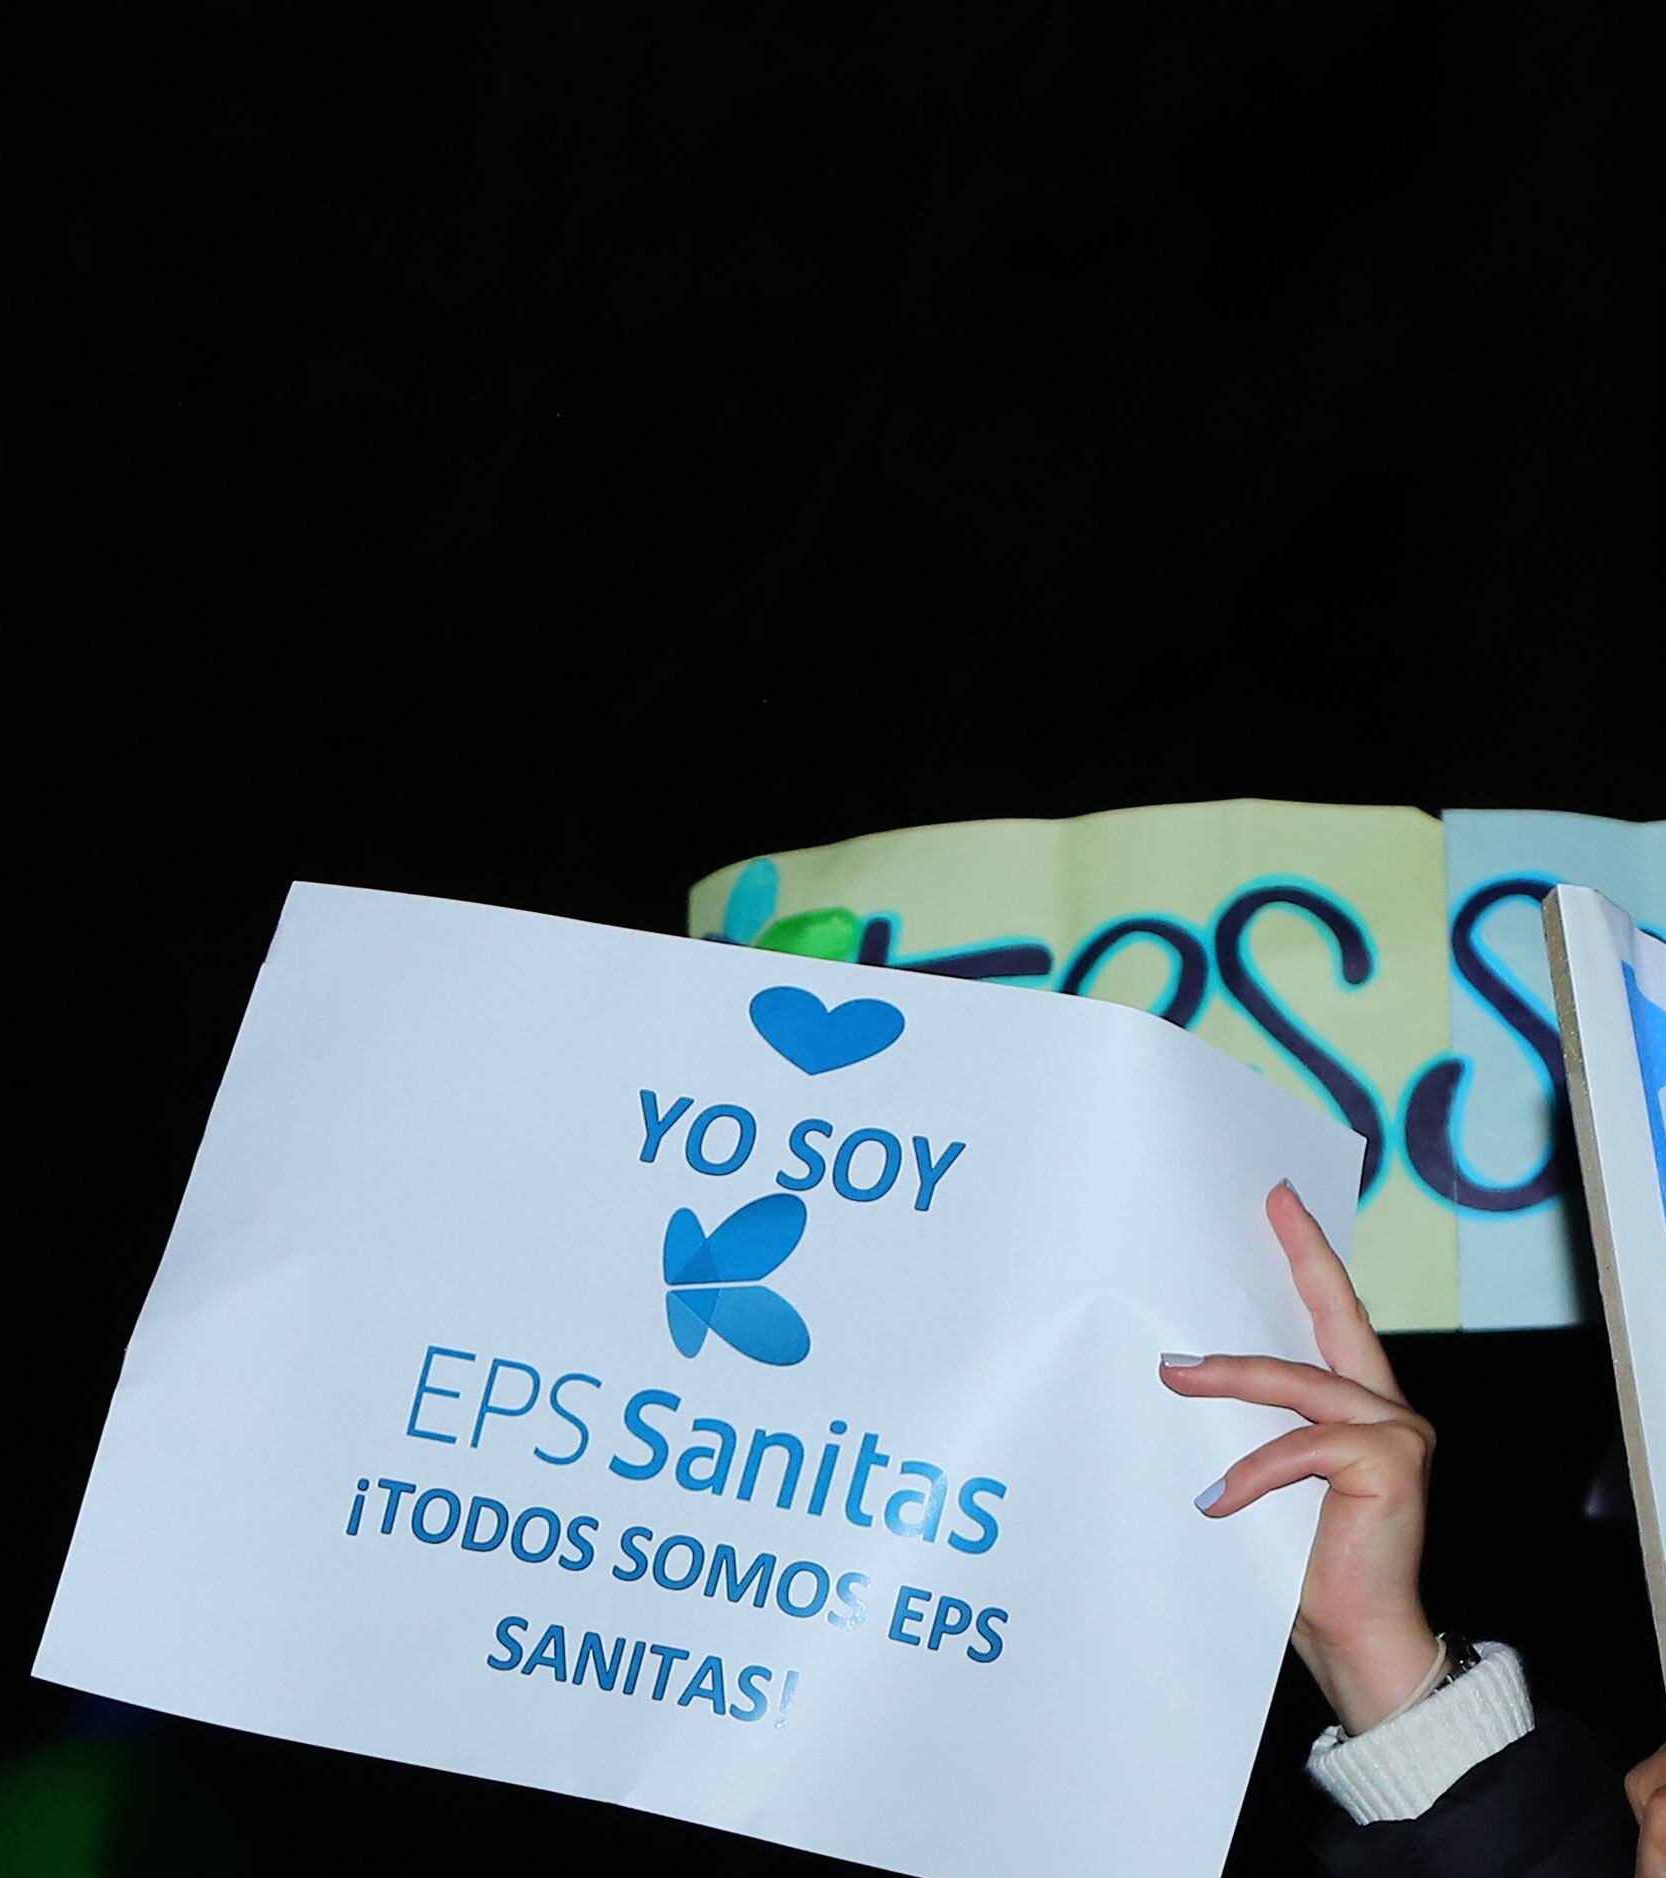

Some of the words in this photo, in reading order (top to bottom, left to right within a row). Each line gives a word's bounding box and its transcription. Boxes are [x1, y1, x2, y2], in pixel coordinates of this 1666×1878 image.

[638, 1089, 757, 1177] YO
[775, 1118, 967, 1212] SOY
[406, 1345, 602, 1466] EPS
[608, 1388, 1007, 1555] Sanitas
[345, 1477, 599, 1572] ¡TODOS
[612, 1526, 870, 1629] SOMOS
[888, 1585, 1009, 1664] EPS
[486, 1615, 798, 1728] SANITAS!
